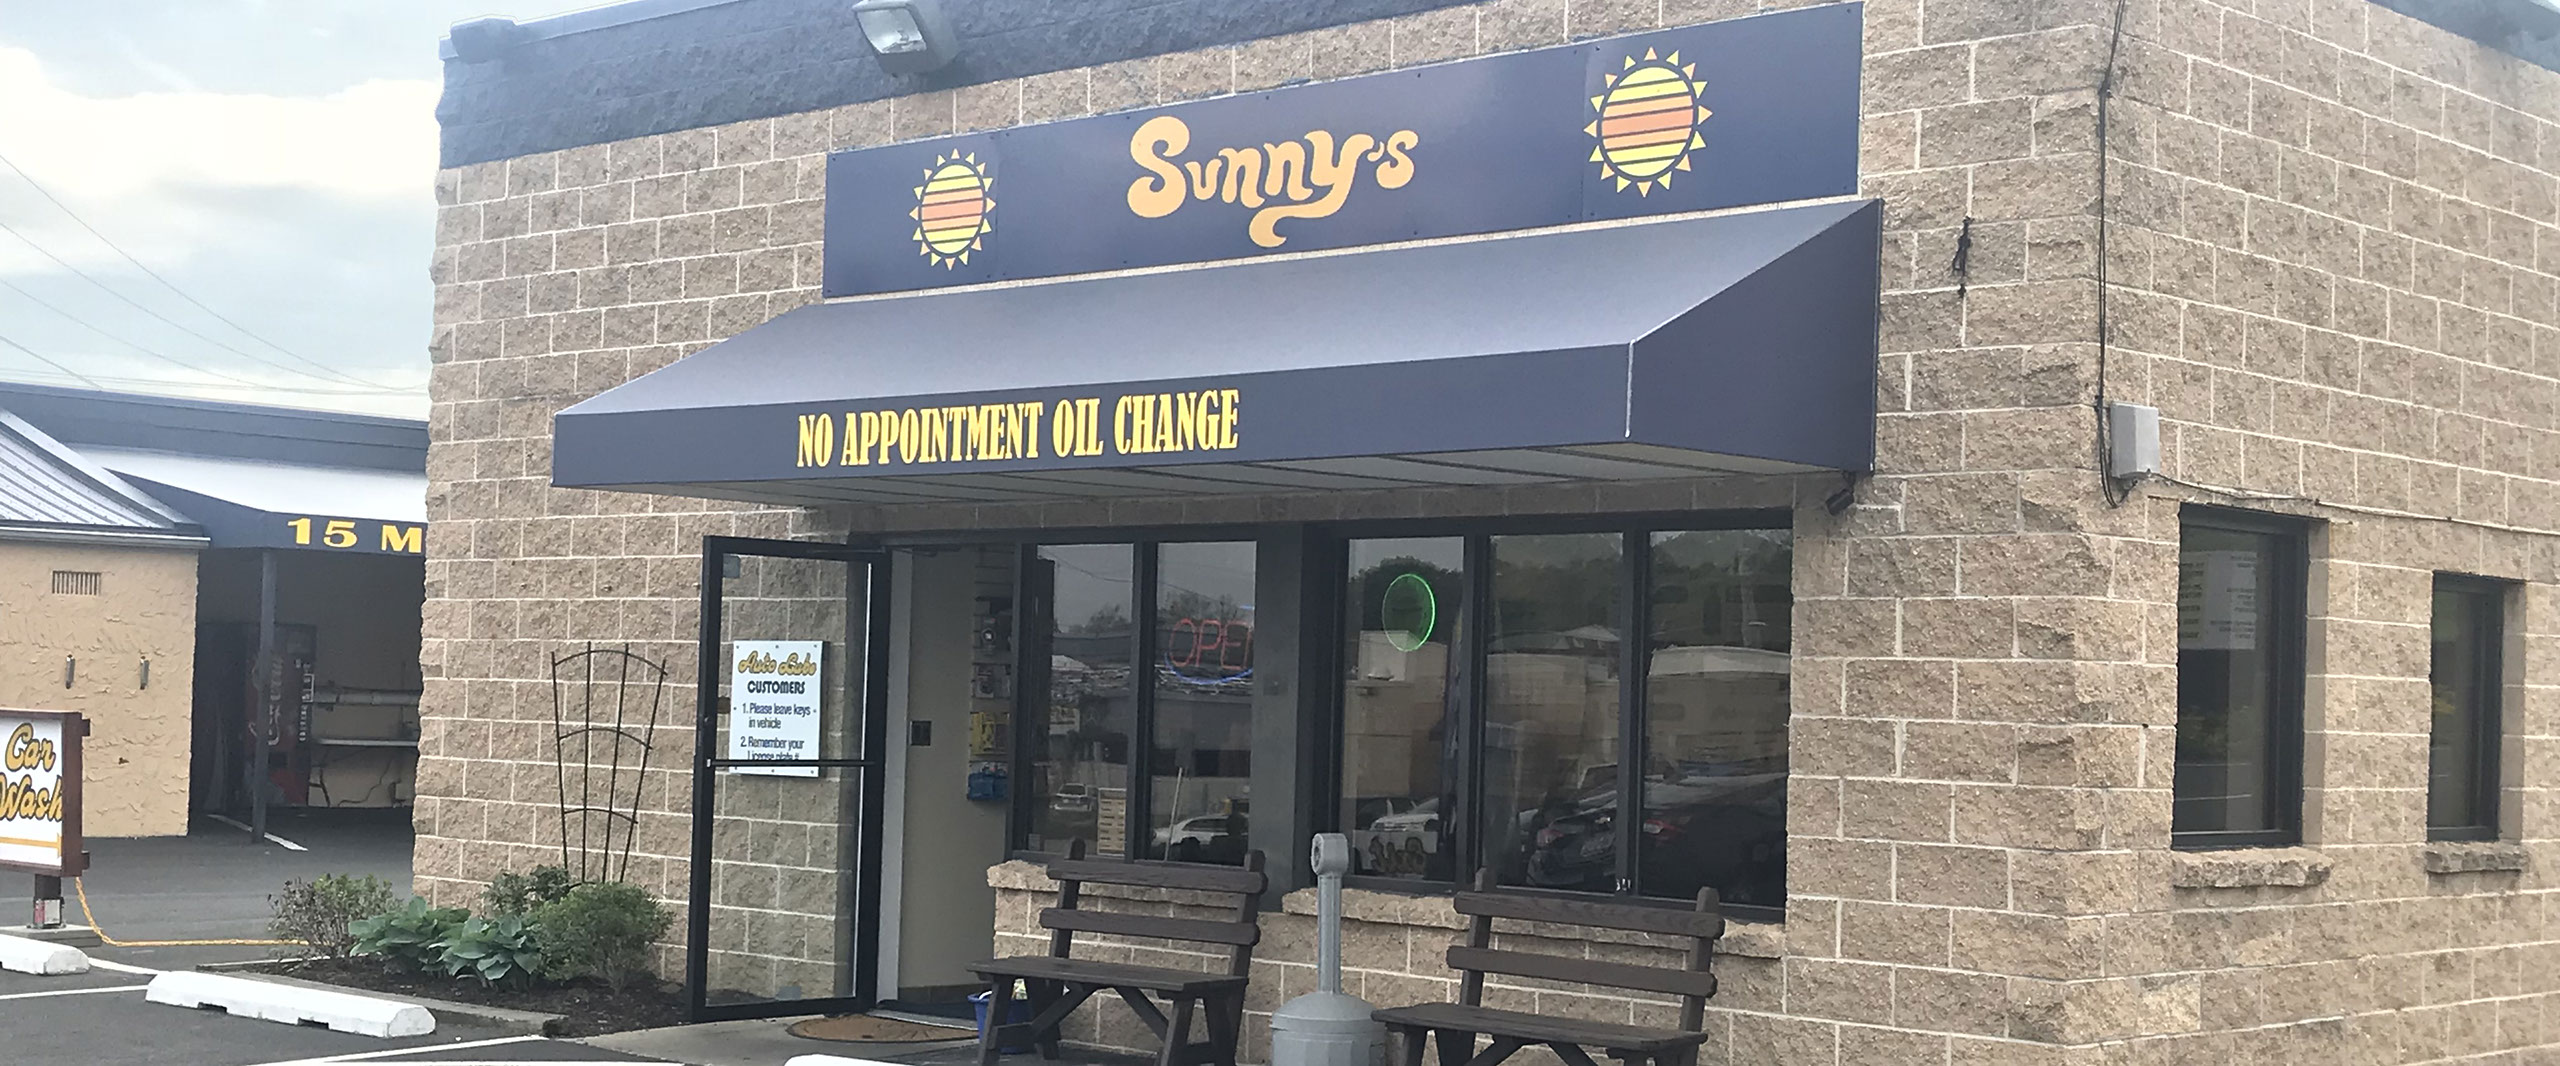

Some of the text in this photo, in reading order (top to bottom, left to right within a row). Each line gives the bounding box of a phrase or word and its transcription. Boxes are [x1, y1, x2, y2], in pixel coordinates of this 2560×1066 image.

[1127, 115, 1419, 248] Sunny's
[797, 389, 1239, 468] NO APPOINTMENT OIL CHANGE
[287, 517, 358, 549] 15
[1169, 617, 1254, 670] OPE
[738, 650, 817, 676] Auto Lube
[747, 680, 805, 694] CUSTOMERS
[742, 703, 811, 718] 1. Please leave keys
[748, 716, 782, 729] in vehicle
[5, 722, 56, 772] Car
[748, 736, 787, 749] Remember
[788, 740, 804, 751] your
